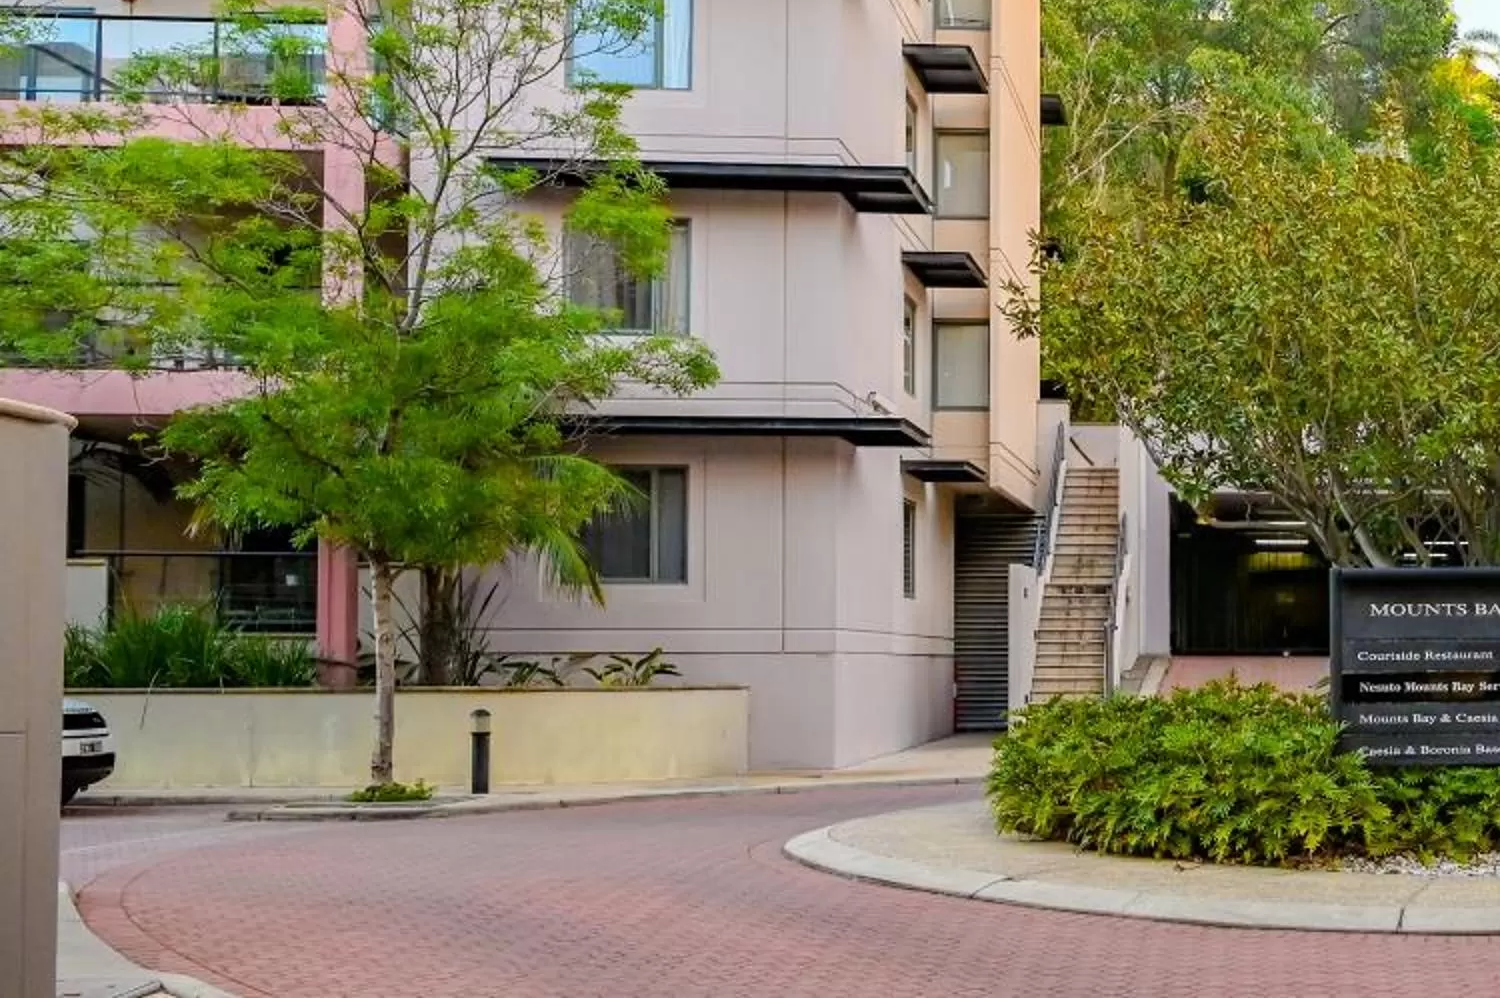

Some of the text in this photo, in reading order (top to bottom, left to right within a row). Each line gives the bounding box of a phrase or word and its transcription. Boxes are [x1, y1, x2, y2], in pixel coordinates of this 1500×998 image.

[1370, 602, 1468, 617] MOUNTS
[1357, 650, 1494, 662] Courtside Restaurant
[1359, 681, 1401, 693] Nesuto
[1404, 681, 1449, 692] Mounts
[1452, 681, 1475, 694] Bay
[1359, 713, 1409, 725] Mounts
[1412, 713, 1437, 726] Bay
[1440, 713, 1452, 724] &
[1455, 713, 1499, 724] Caesia
[1405, 745, 1417, 755] &
[1420, 745, 1471, 756] Boronia
